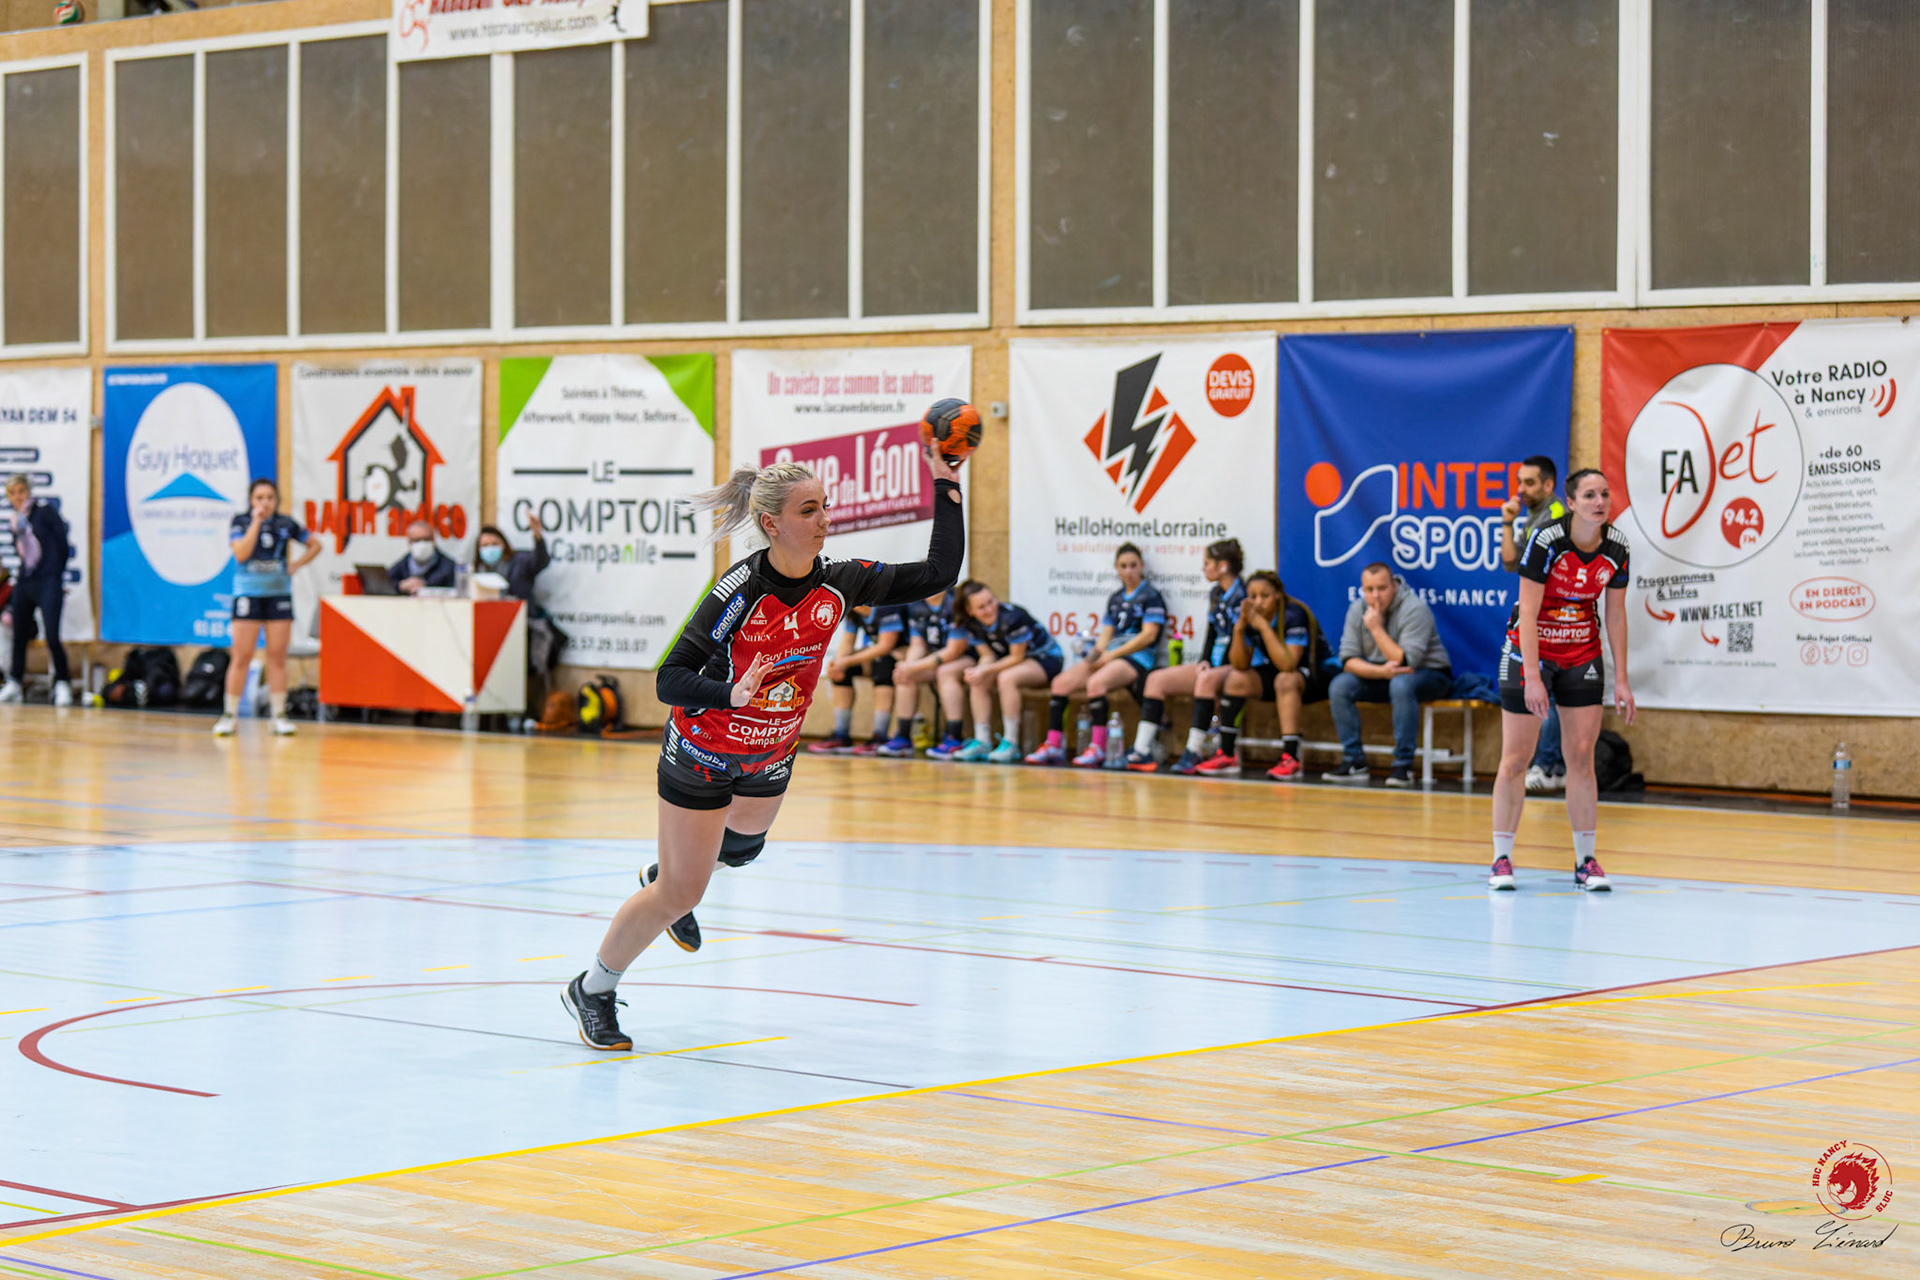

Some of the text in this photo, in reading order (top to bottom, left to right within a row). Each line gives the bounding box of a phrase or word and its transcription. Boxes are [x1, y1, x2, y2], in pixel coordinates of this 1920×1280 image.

[1209, 370, 1252, 387] DEVIS
[1771, 360, 1887, 387] Votre RADIO
[1209, 386, 1252, 401] GRATUIT
[1794, 387, 1866, 405] à Nancy
[1805, 405, 1862, 418] & environs
[136, 441, 240, 474] Guy Hoquet
[1846, 444, 1862, 457] 60
[593, 461, 615, 483] LE
[855, 431, 921, 503] Léon
[1808, 459, 1881, 477] ÉMISSIONS
[513, 498, 697, 534] COMPTOIR
[1724, 508, 1759, 526] 94.2
[1055, 517, 1227, 538] HelloHomeLorraine
[551, 538, 657, 571] Campanile
[1574, 568, 1587, 588] 5
[1636, 572, 1716, 588] Programmes
[1669, 588, 1698, 600] Infos
[1823, 586, 1862, 597] DIRECT
[1679, 601, 1763, 622] WWW.FAJET.NET
[1816, 598, 1866, 610] PODCAST
[1049, 612, 1077, 637] 06
[761, 642, 823, 664] Guy Hoquet
